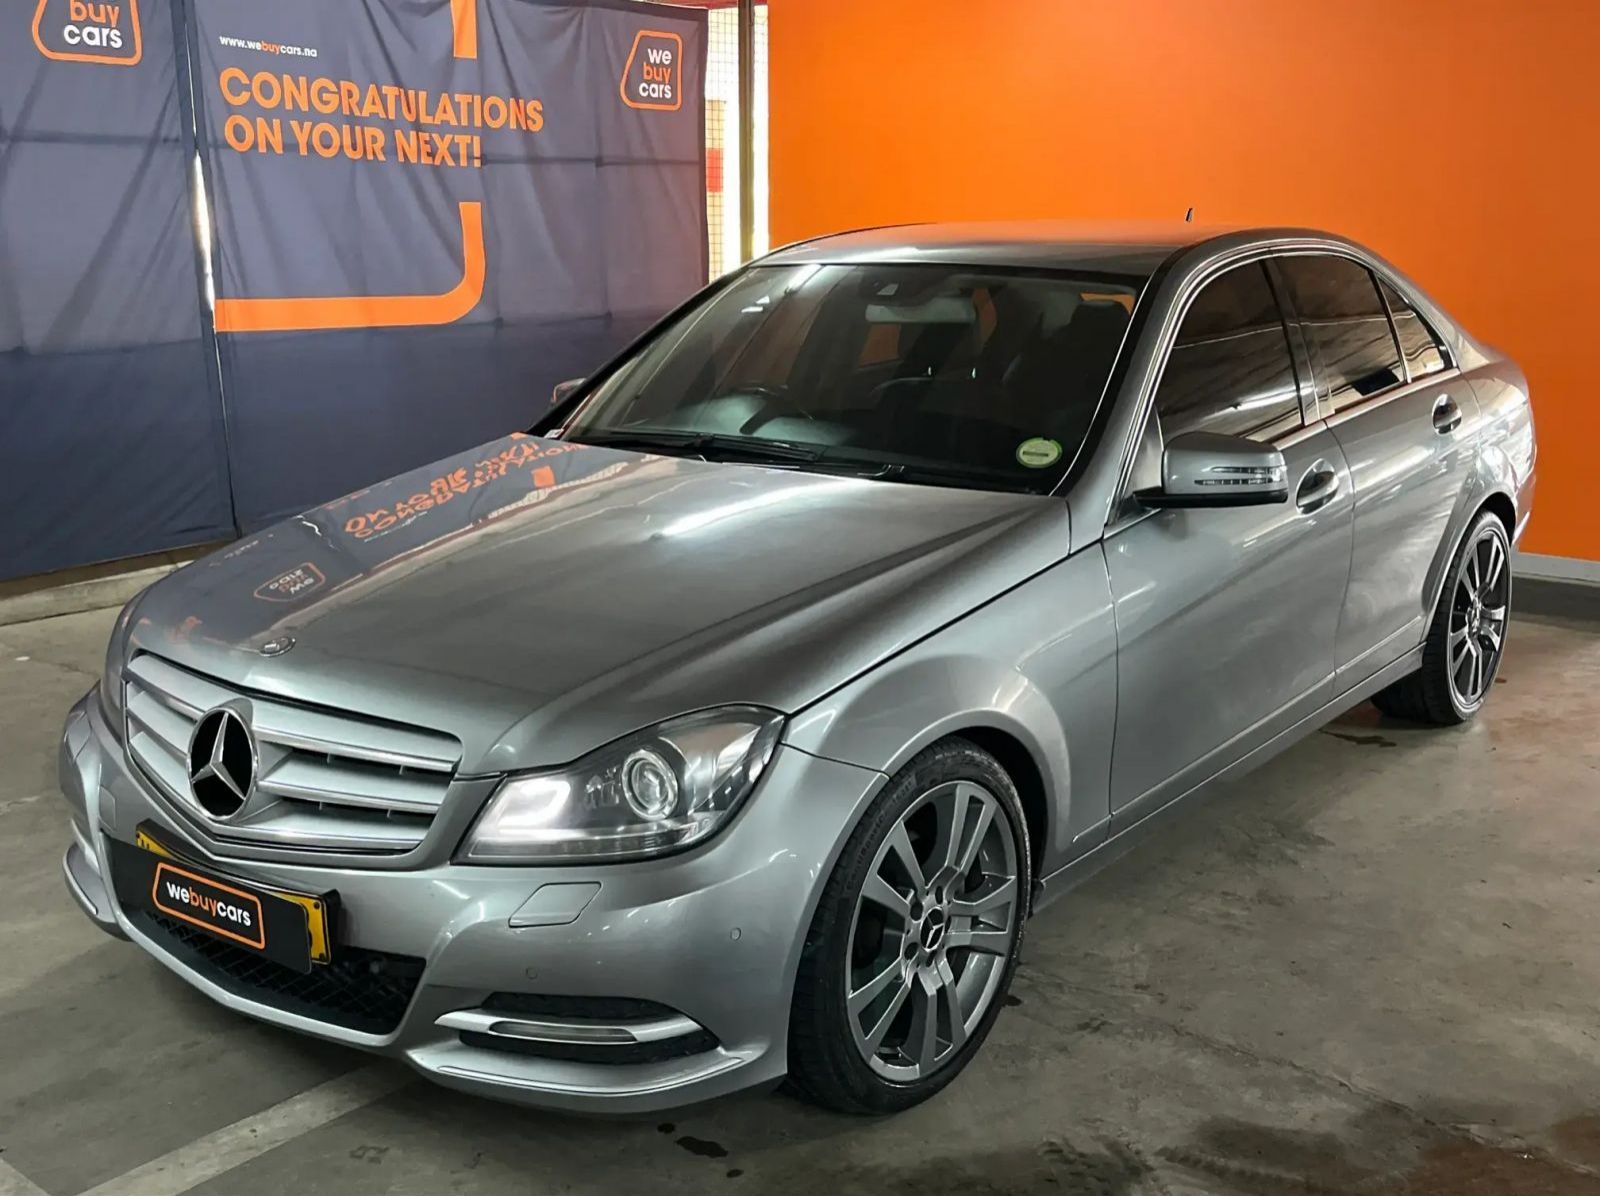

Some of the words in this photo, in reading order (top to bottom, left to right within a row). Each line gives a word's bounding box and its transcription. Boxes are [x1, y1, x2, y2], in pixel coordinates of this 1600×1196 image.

[70, 0, 119, 27] buy
[63, 24, 123, 48] cars
[219, 35, 318, 57] www.webuycars.na
[647, 47, 672, 65] we
[643, 61, 671, 84] buy
[219, 67, 544, 132] CONGRATULATIONS
[638, 82, 672, 98] cars
[224, 115, 283, 154] ON
[290, 119, 386, 162] YOUR
[394, 129, 482, 168] NEXT!
[166, 881, 251, 927] webuycars
